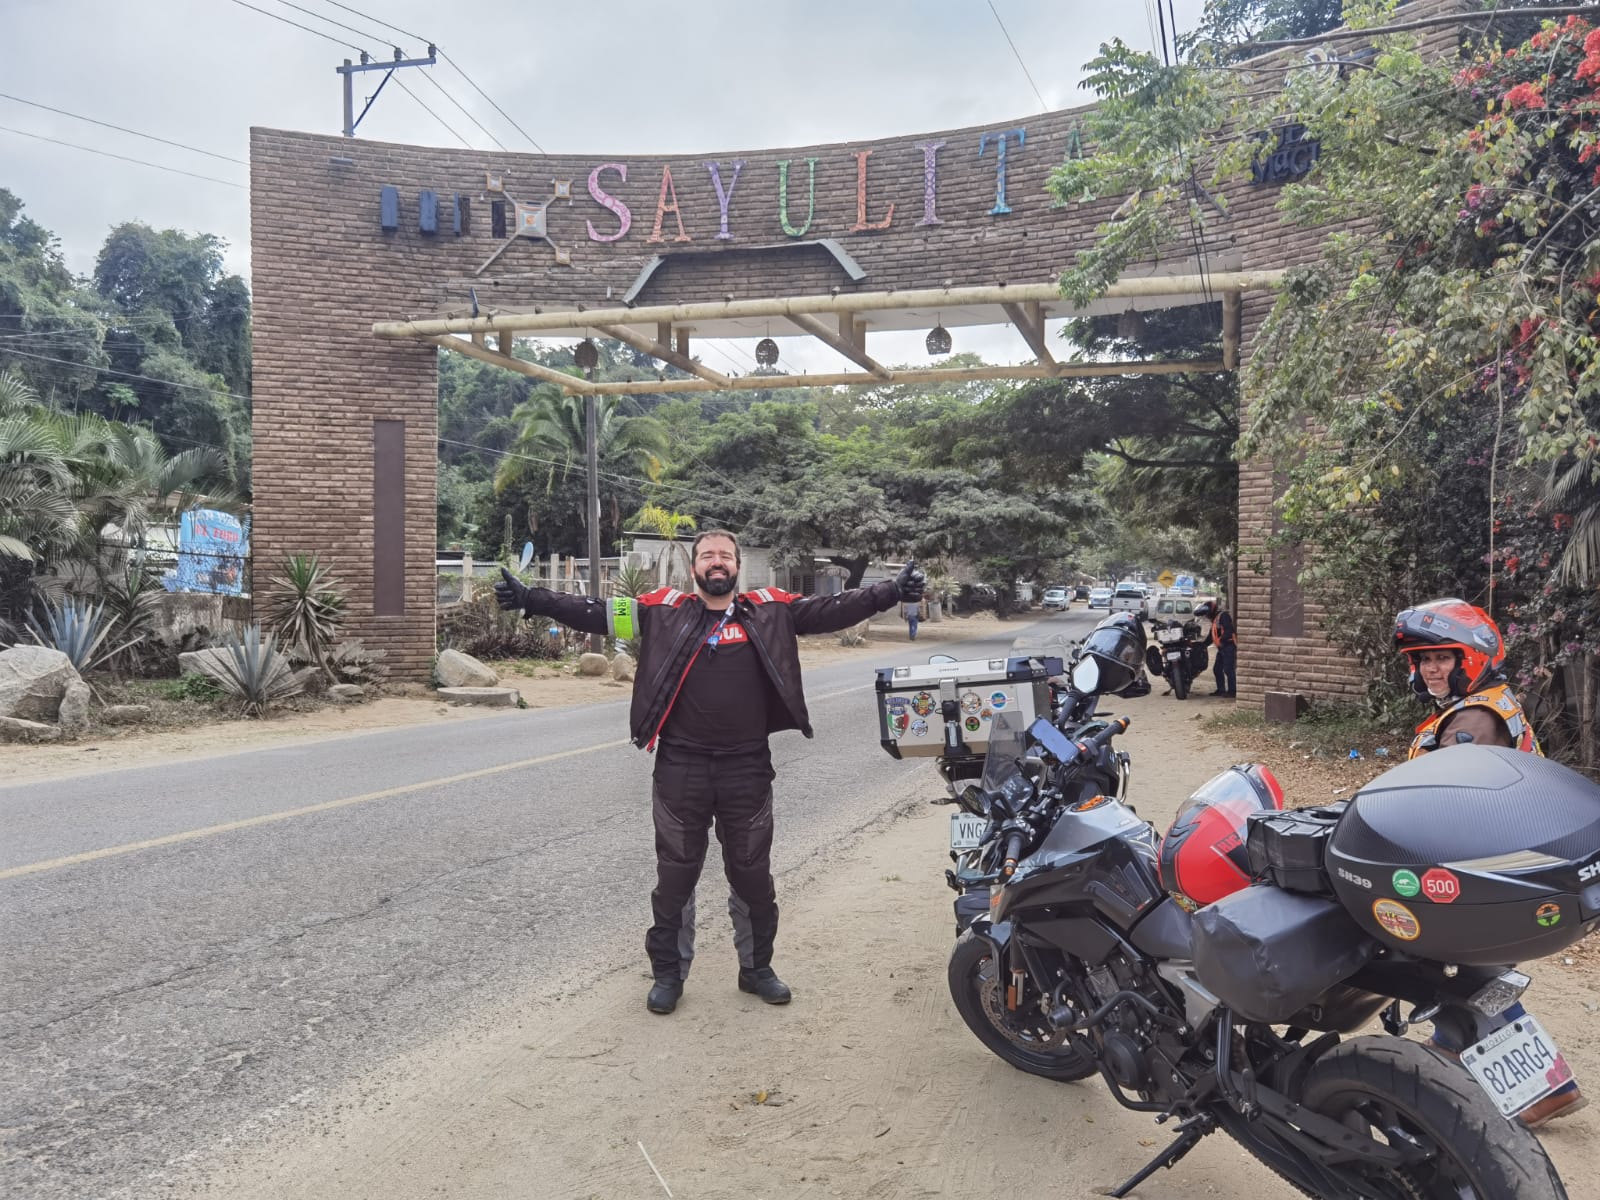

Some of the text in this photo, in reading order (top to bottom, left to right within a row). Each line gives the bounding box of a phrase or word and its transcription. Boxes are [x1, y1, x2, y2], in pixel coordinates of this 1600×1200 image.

[1338, 867, 1373, 889] SH39
[1426, 879, 1455, 894] 500
[1482, 1035, 1555, 1095] 82ARG4
